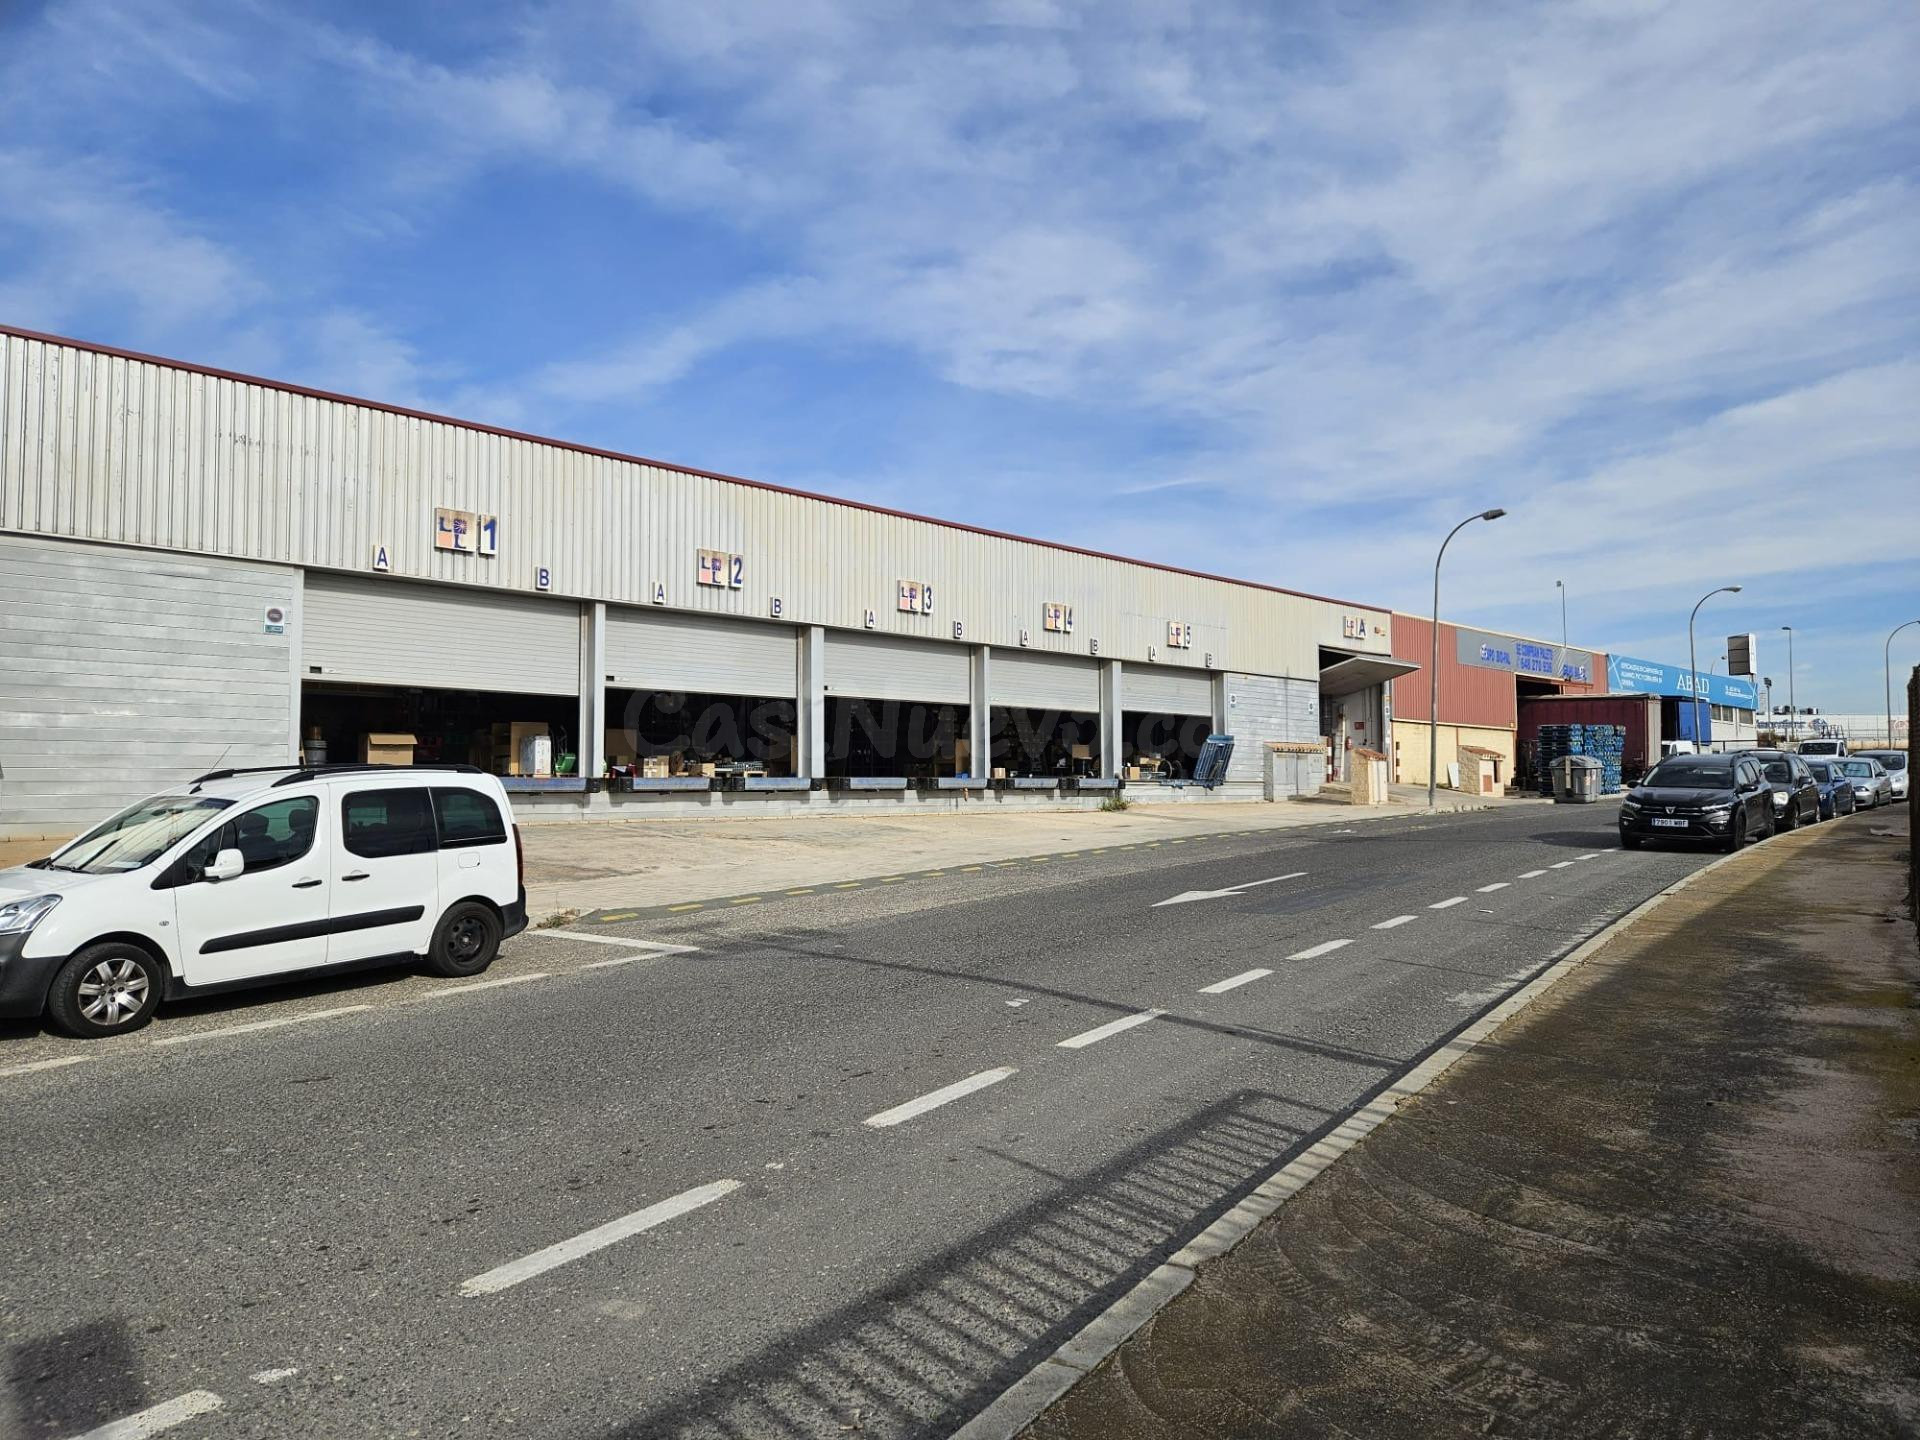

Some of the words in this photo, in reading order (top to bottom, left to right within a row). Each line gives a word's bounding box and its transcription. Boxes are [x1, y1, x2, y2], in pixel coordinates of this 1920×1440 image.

[484, 519, 496, 550] 1
[377, 547, 388, 566] A
[539, 569, 549, 586] B
[734, 557, 743, 584] 2
[656, 583, 664, 600] A
[926, 586, 932, 610] 3
[774, 598, 782, 614] B
[869, 611, 875, 625] A
[1067, 608, 1073, 628] 4
[957, 622, 963, 636] B
[1187, 626, 1191, 644] 5
[1359, 619, 1366, 636] A
[1024, 631, 1029, 643] A
[1093, 639, 1099, 652] B
[1152, 647, 1157, 658] A
[1208, 654, 1213, 665] B
[1677, 674, 1710, 694] ABAD
